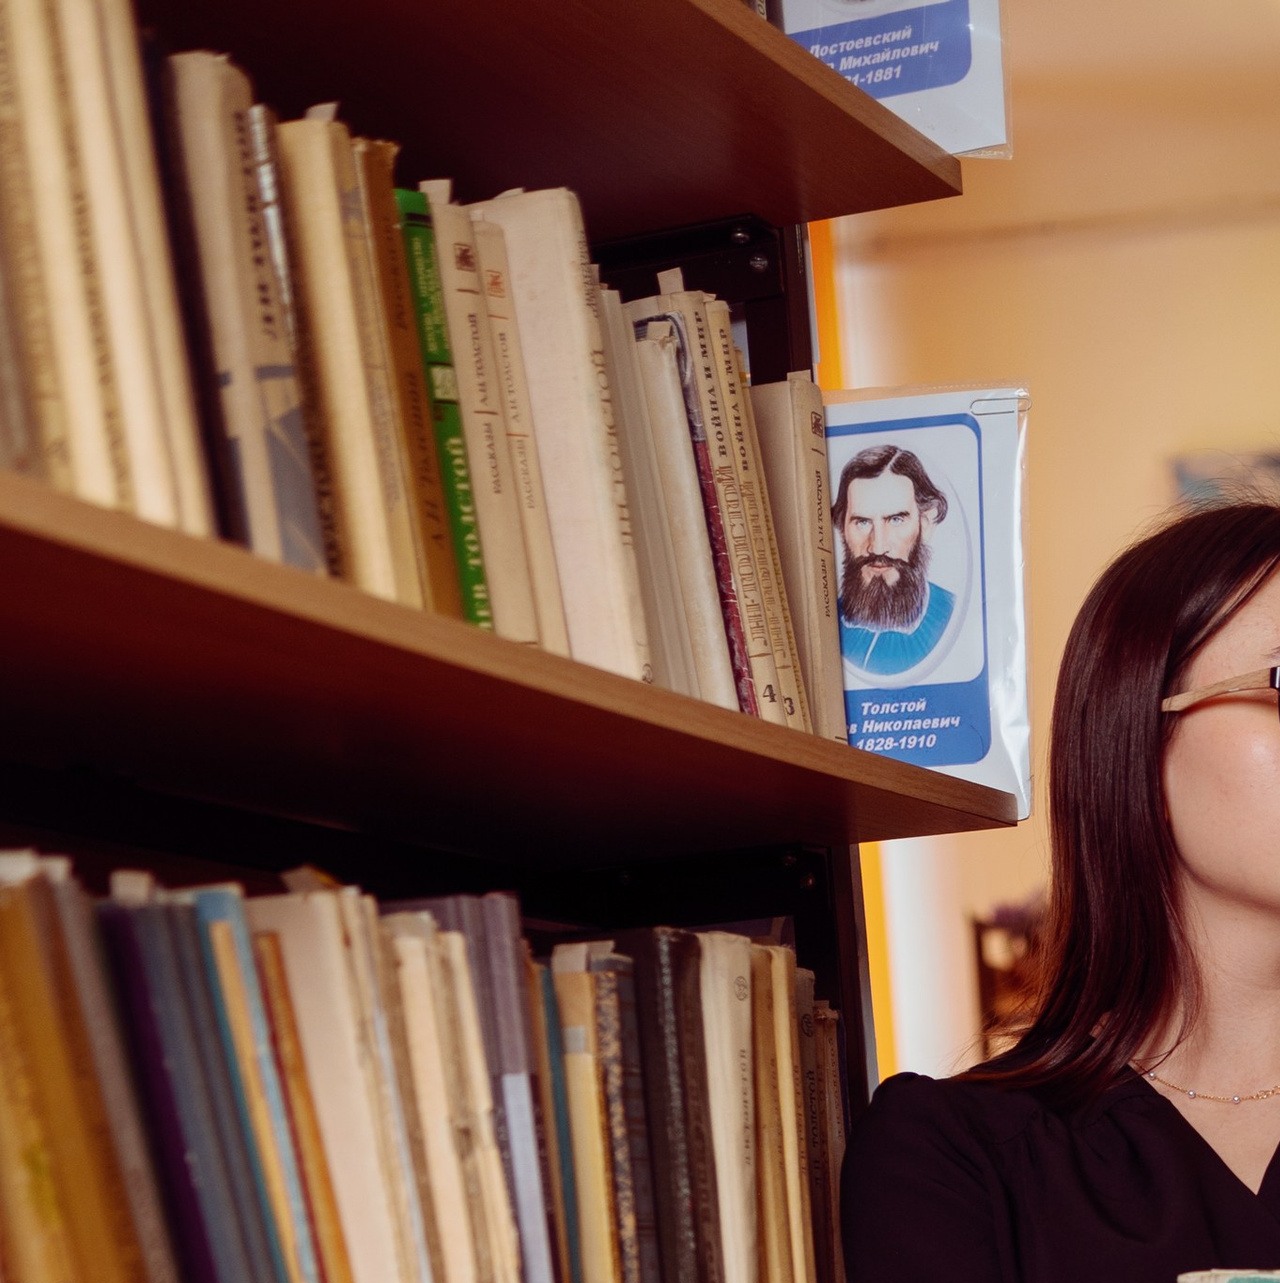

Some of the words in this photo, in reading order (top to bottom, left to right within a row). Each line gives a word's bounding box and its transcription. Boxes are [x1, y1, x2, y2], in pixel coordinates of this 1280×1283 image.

[810, 26, 912, 59] Достоевский
[840, 40, 940, 71] Михайлович
[844, 65, 902, 86] 1-1881
[861, 697, 927, 716] Толстой
[861, 715, 960, 734] Николаевич
[856, 733, 938, 753] 1828-1910
